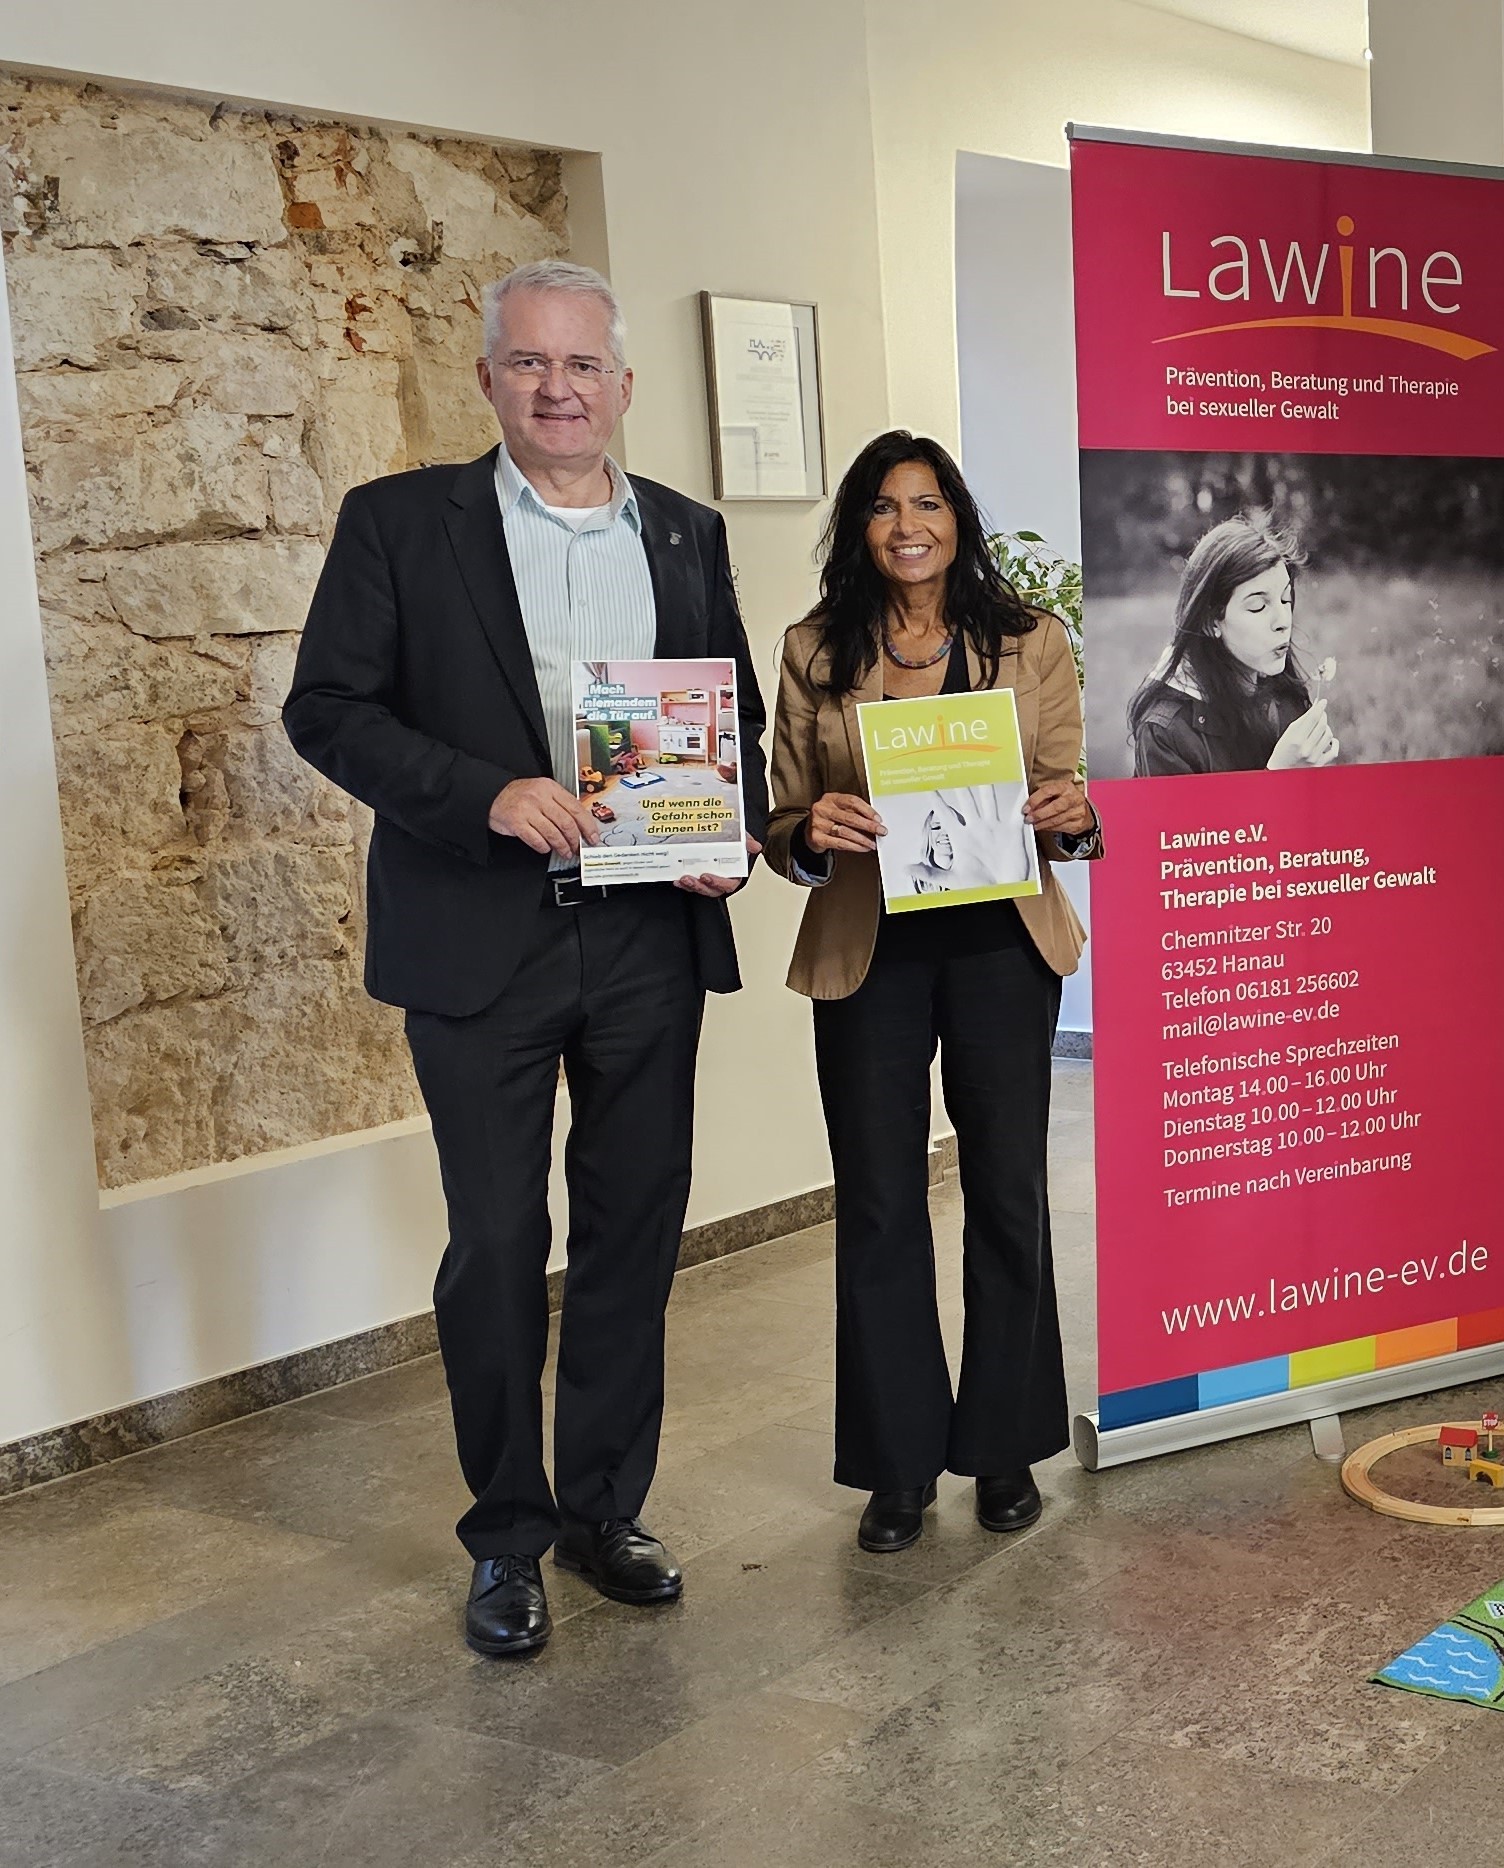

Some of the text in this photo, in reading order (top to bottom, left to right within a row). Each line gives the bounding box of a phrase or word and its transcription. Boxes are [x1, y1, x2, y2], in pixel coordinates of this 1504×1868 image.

[1162, 215, 1463, 315] Lawine
[1165, 366, 1460, 398] Prävention, Beratung und Therapie
[1166, 395, 1340, 422] bei sexueller Gewalt
[584, 697, 656, 708] niemandem
[589, 684, 624, 695] Mach
[587, 710, 656, 721] die Tür auf.
[874, 714, 988, 751] Lawine
[642, 800, 665, 809] Und
[703, 798, 722, 807] die
[652, 811, 732, 821] Gefahr schon
[648, 823, 719, 834] drinnen ist?
[1160, 823, 1268, 851] Lawine e.V.
[1160, 845, 1371, 880] Prävention, Beratung,
[1160, 867, 1437, 911] Therapie bei sexueller Gewalt
[1161, 916, 1332, 951] Chemnitzer Str. 20
[1161, 953, 1286, 981] 63452 Hanau
[1162, 970, 1360, 1011] Telefon 06181 256602
[1162, 1002, 1340, 1040] mail@lawine-ev.de
[1163, 1031, 1400, 1081] Telefonische Sprechzeiten
[1163, 1077, 1234, 1109] Montag
[1239, 1073, 1288, 1098] 14.00
[1305, 1065, 1351, 1088] 16.00
[1355, 1061, 1388, 1082] Uhr
[1164, 1106, 1246, 1138] Dienstag
[1251, 1100, 1299, 1126] 10.00
[1315, 1091, 1361, 1115] 12.00
[1366, 1086, 1398, 1108] Uhr
[1164, 1133, 1272, 1168] Donnerstag
[1277, 1125, 1324, 1150] 10.00
[1340, 1117, 1386, 1139] 12.00
[1390, 1111, 1422, 1133] Uhr
[1164, 1150, 1413, 1208] Termine nach Vereinbarung
[1161, 1240, 1489, 1335] www.lawine-ev.de
